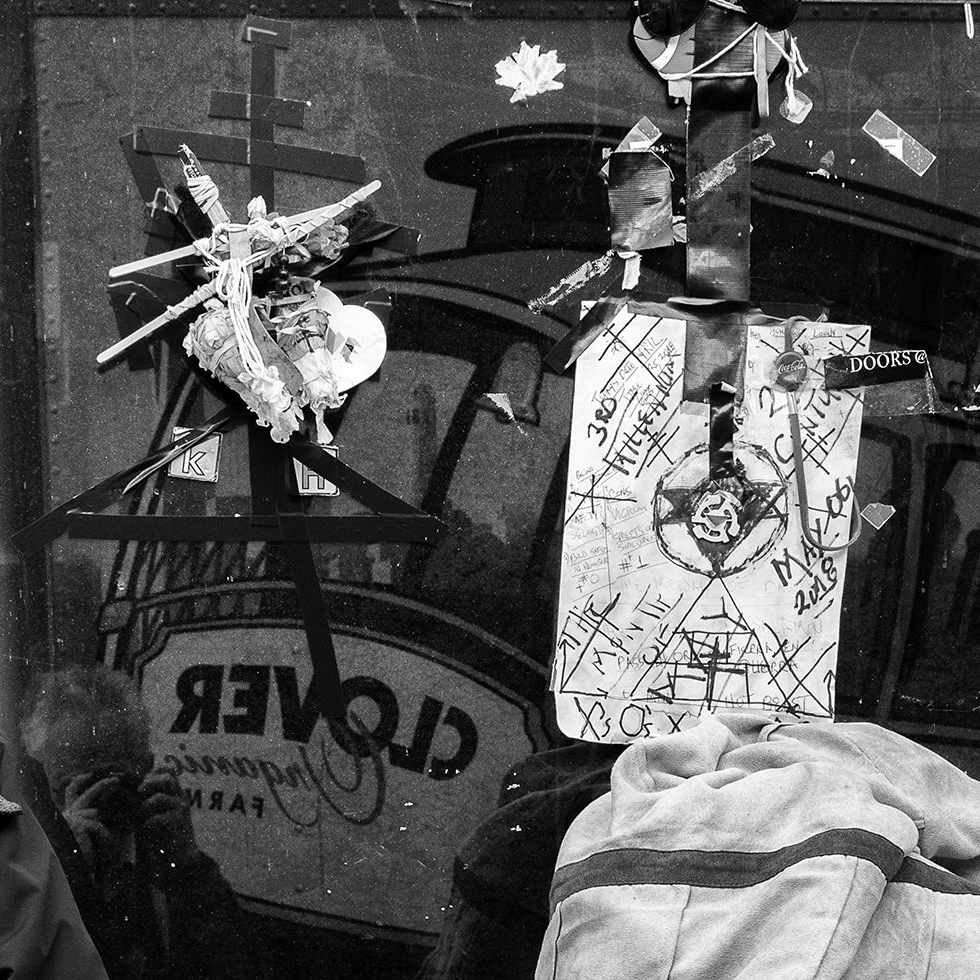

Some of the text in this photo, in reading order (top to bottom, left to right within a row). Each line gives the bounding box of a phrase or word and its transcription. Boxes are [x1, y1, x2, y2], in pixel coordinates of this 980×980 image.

[849, 352, 911, 374] DOORS
[588, 397, 617, 447] 3RD
[182, 448, 207, 476] K
[770, 518, 824, 587] MAY
